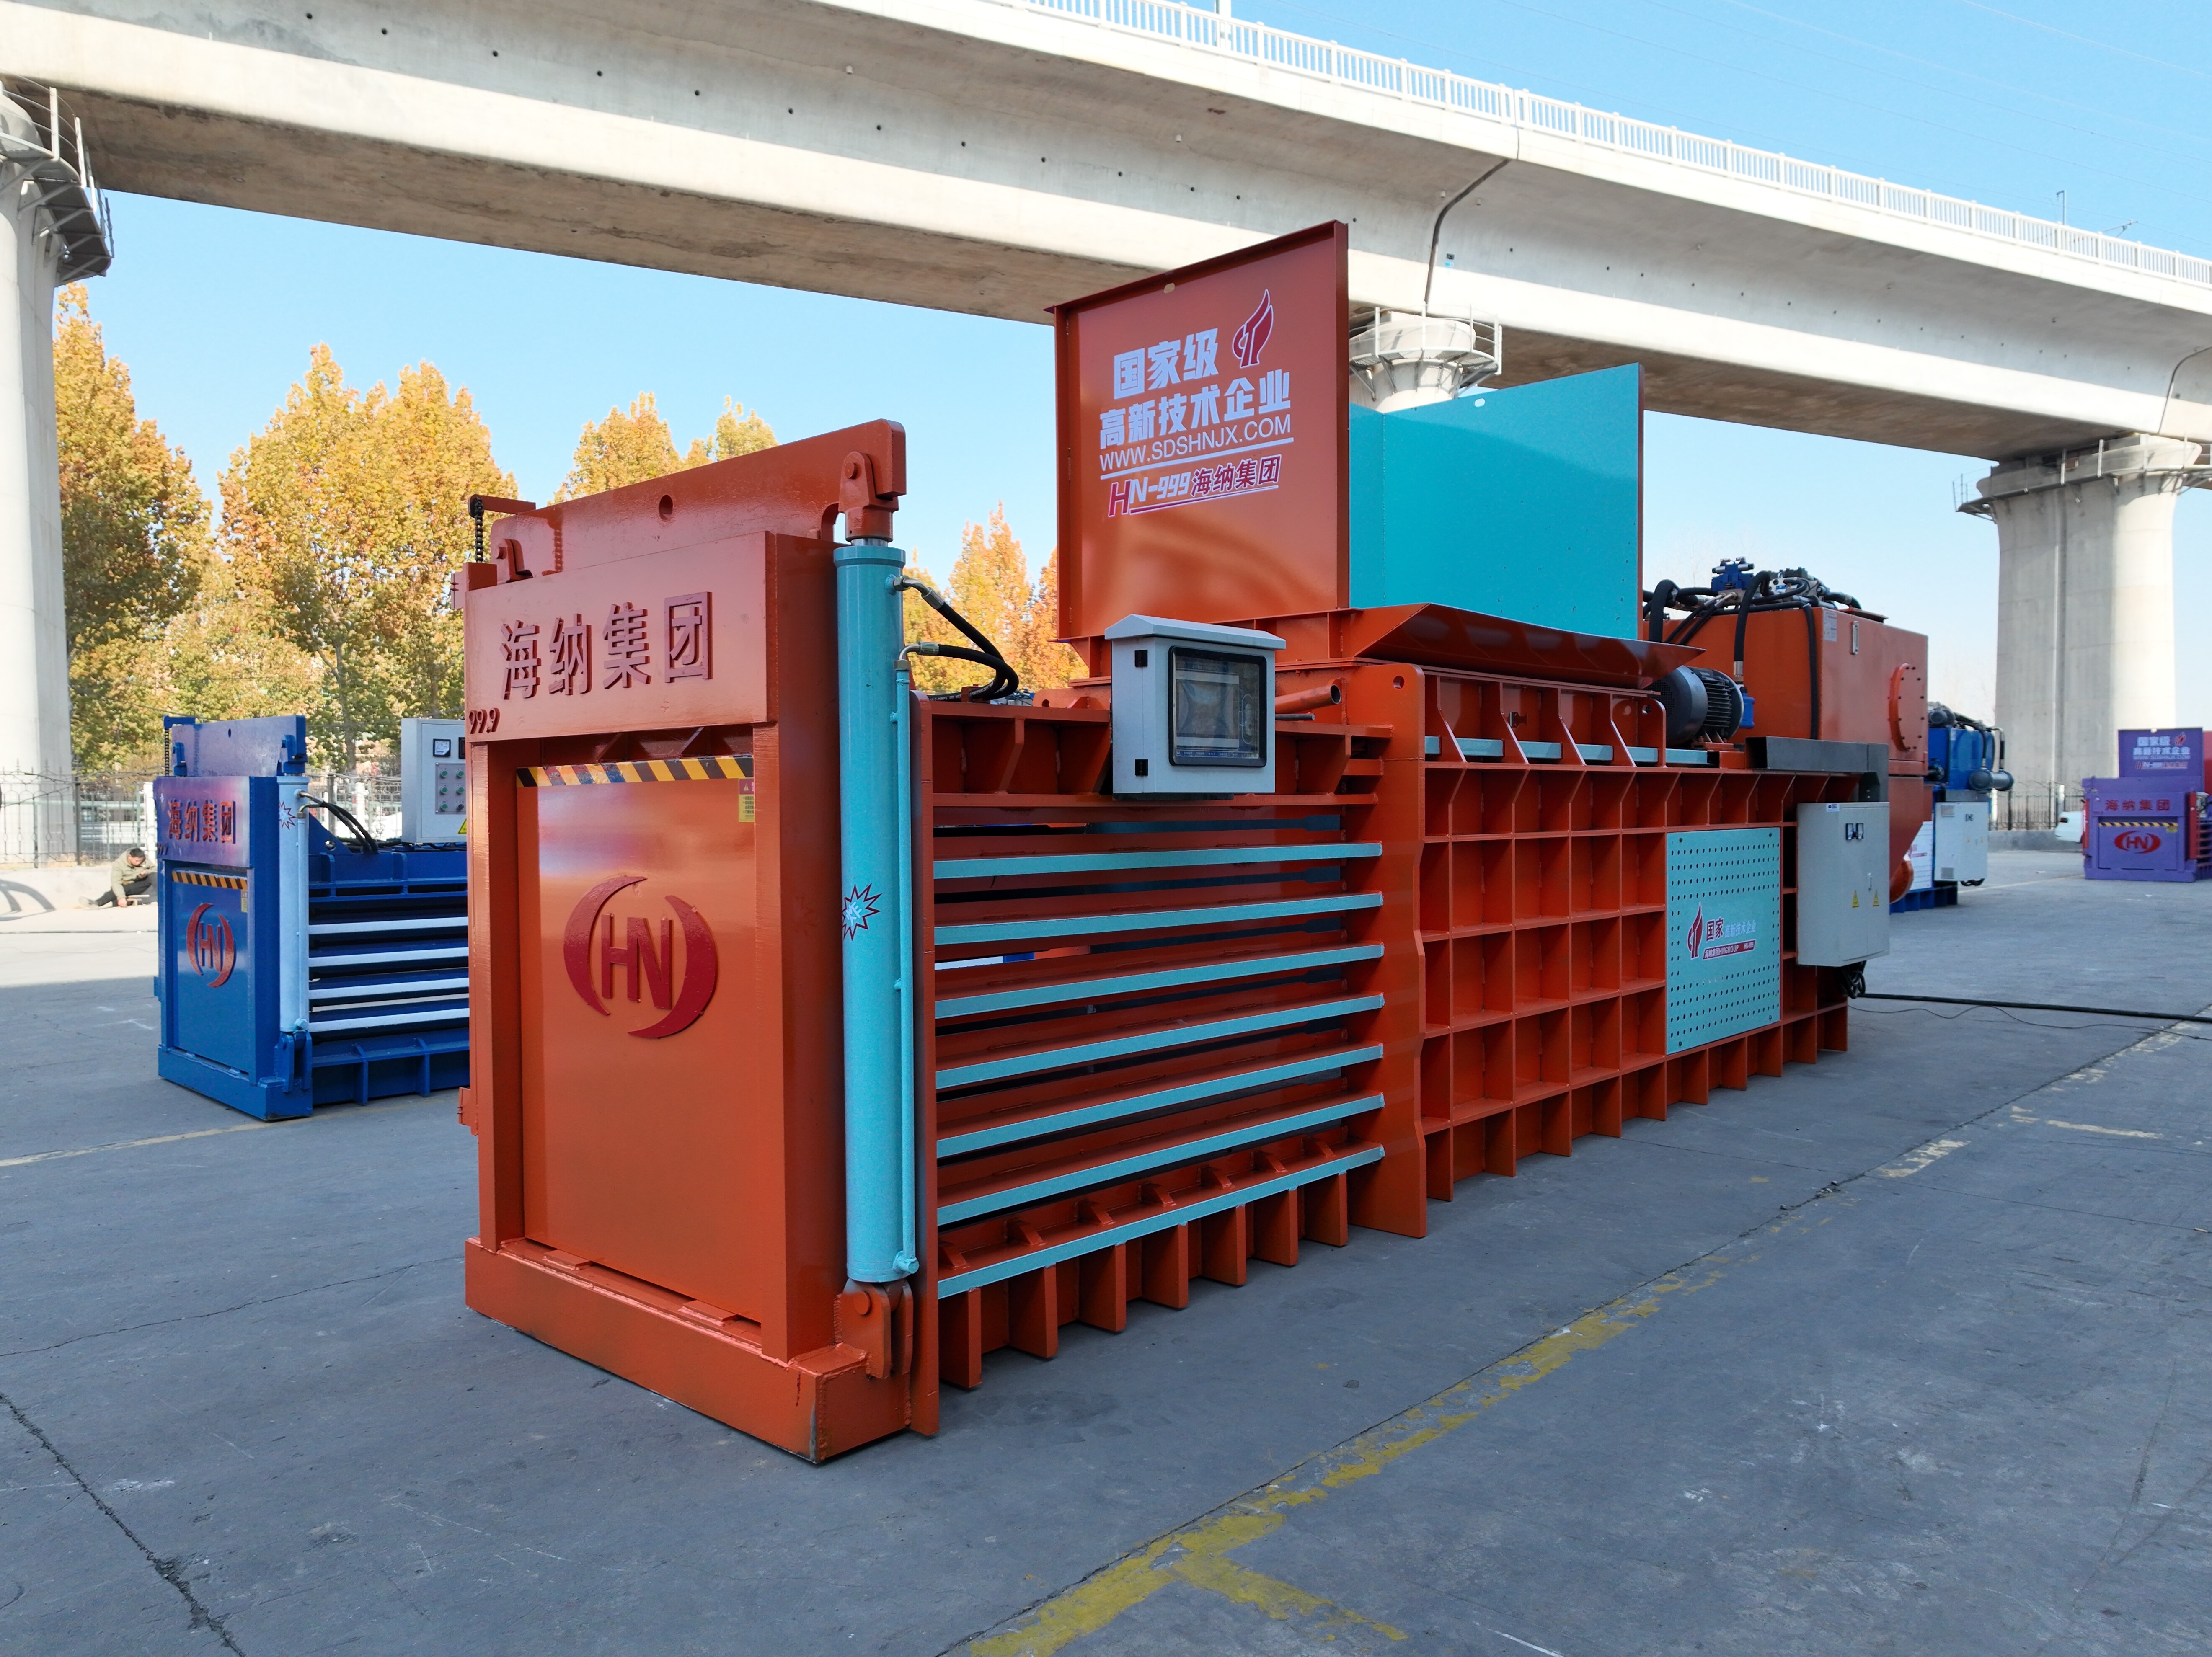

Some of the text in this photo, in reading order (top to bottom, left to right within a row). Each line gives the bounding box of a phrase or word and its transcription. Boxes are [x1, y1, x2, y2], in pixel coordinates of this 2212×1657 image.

[1113, 328, 1218, 400] 国家级
[1100, 369, 1291, 449] 高新技术企业
[1100, 414, 1291, 471] WWW.SDSHNJX.COM
[500, 591, 713, 700] 海纳集团
[167, 799, 236, 844] 海纳集团
[2106, 800, 2170, 810] 海纳集团
[2126, 836, 2148, 849] HN
[198, 922, 222, 972] HN
[600, 912, 673, 1010] HN
